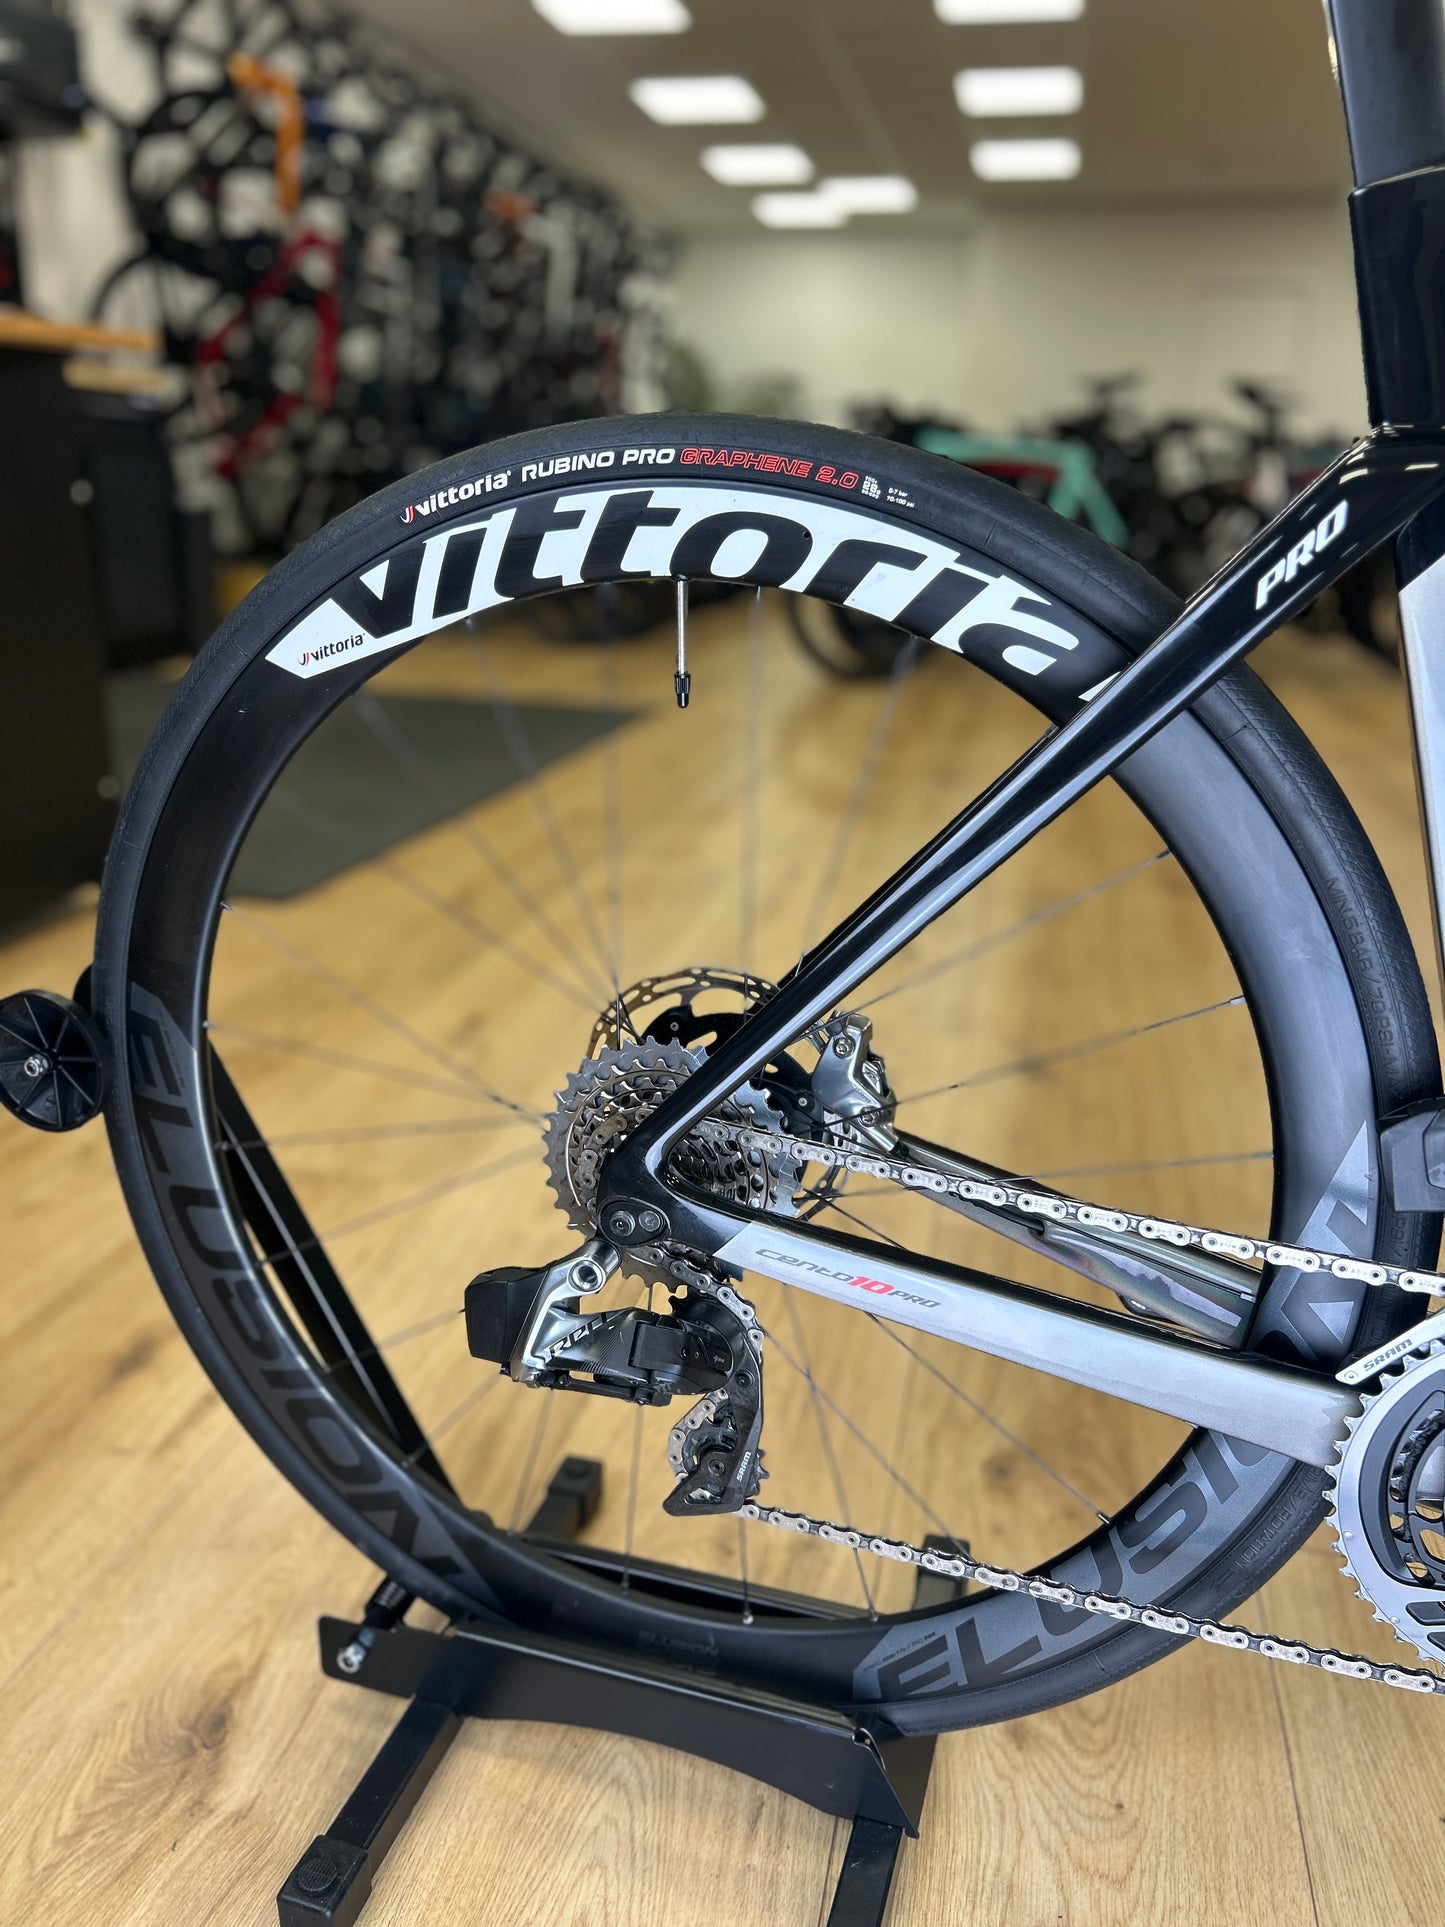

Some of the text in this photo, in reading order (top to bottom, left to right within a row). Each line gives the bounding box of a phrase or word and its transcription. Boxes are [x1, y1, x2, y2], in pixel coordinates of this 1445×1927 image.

[414, 447, 858, 516] vittoria RUBINO PRO GRAPHENE 2.0
[1255, 499, 1348, 610] PRO
[310, 633, 364, 661] vittoria
[130, 1008, 463, 1580] ELUSION
[1363, 1338, 1413, 1371] SRAM
[736, 1451, 752, 1482] SRAM
